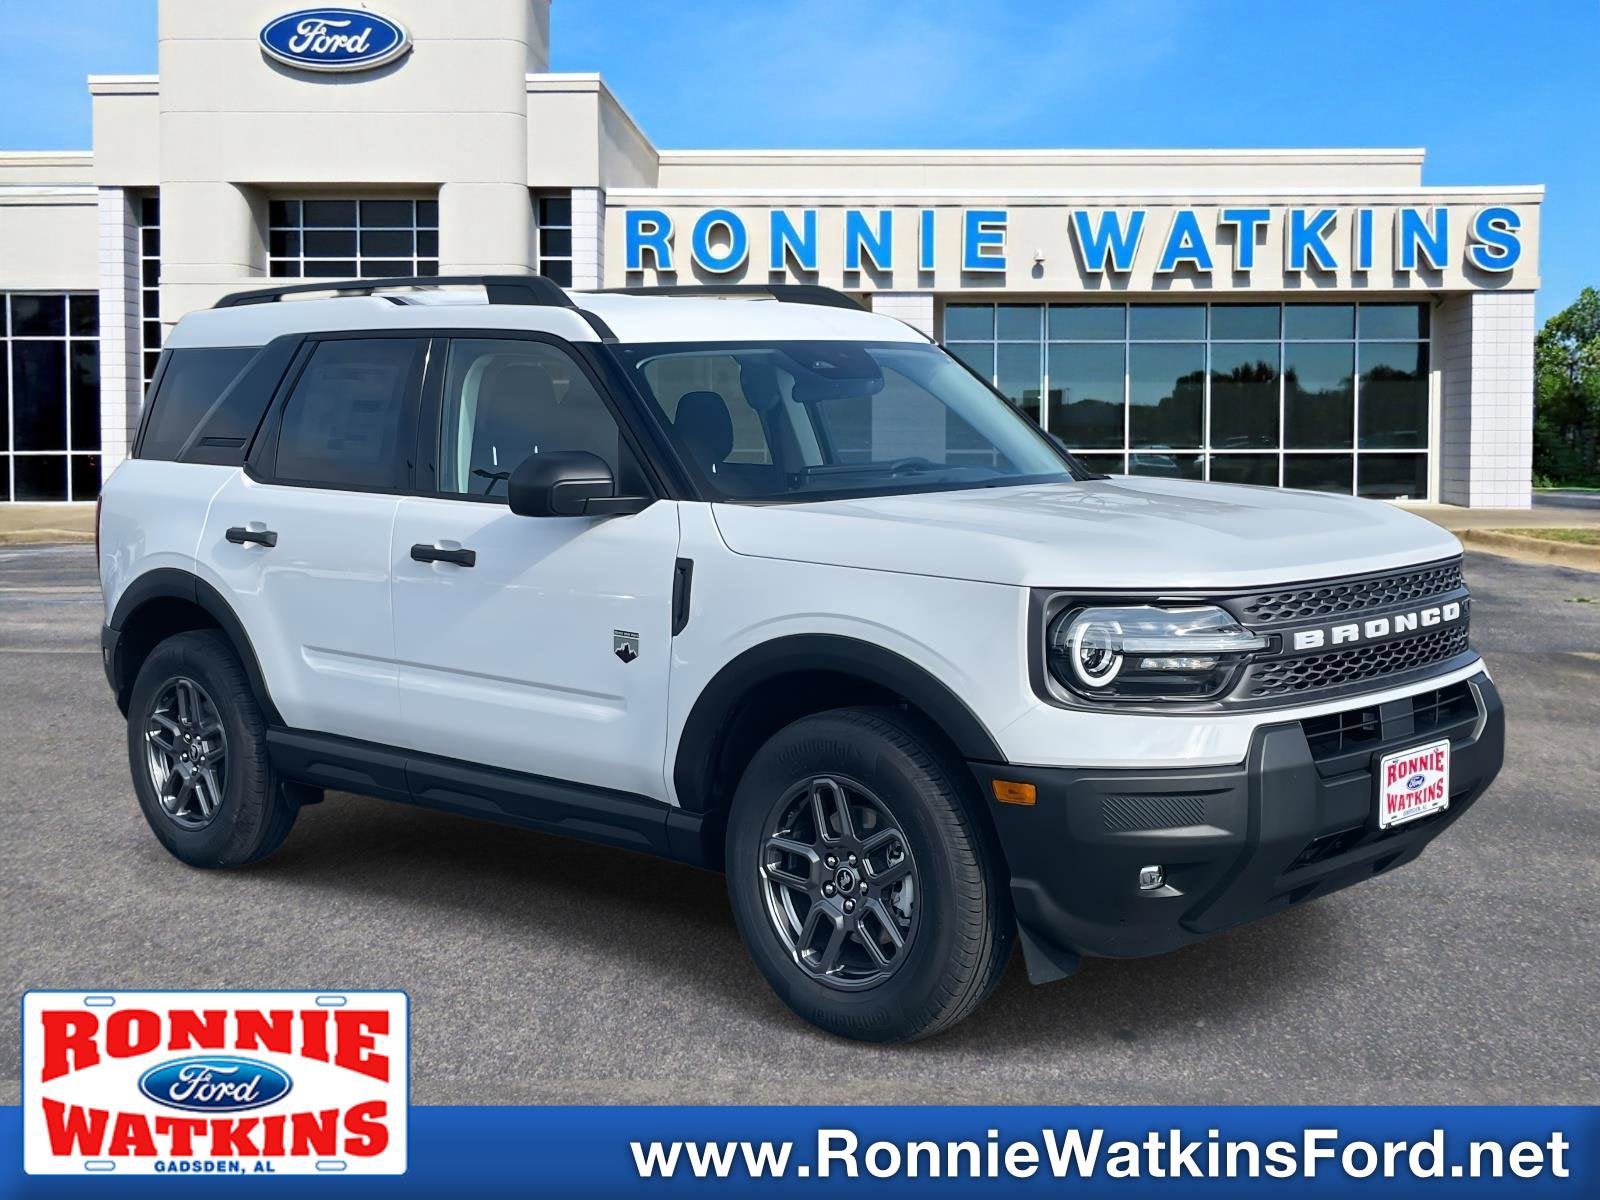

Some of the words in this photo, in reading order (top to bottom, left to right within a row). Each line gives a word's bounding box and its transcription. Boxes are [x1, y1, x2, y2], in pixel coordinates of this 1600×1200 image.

[288, 18, 373, 54] Ford
[624, 208, 1008, 273] RONNIE
[1068, 206, 1523, 273] WATKINS
[1293, 602, 1460, 650] BRONCO
[1387, 751, 1444, 787] RONNIE
[1387, 777, 1444, 814] WATKINS
